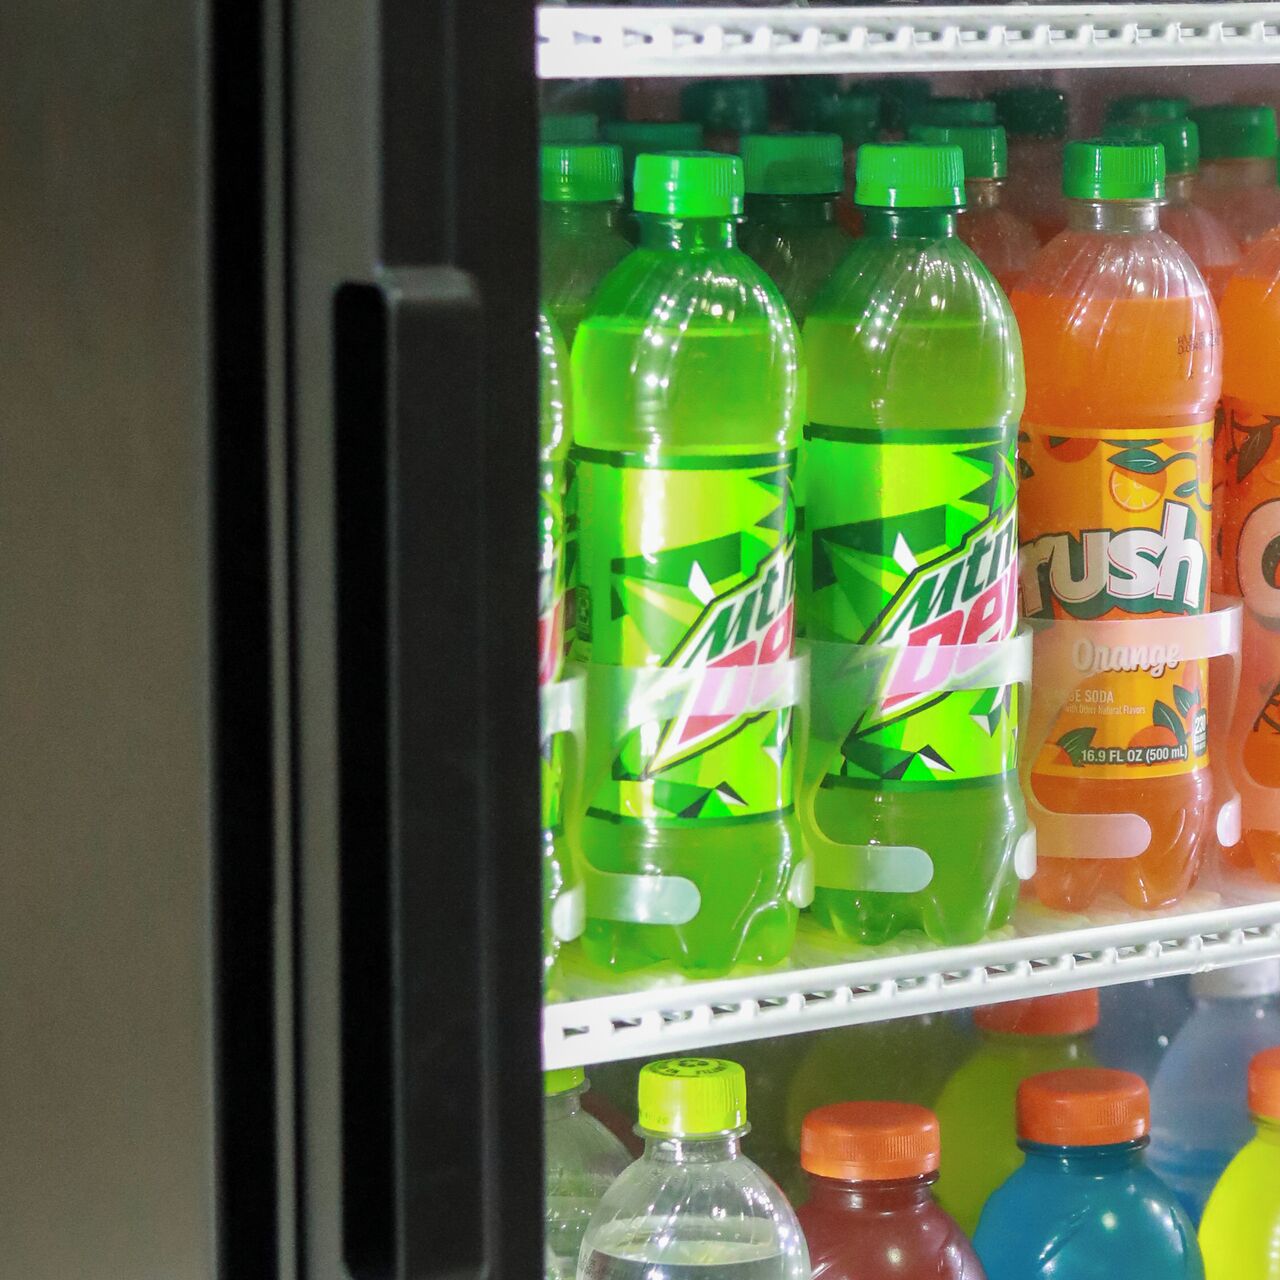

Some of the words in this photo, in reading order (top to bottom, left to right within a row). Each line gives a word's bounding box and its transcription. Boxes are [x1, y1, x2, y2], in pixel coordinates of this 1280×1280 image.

[1018, 502, 1205, 618] rush
[882, 560, 1018, 711] De
[1071, 638, 1181, 678] Orange
[1085, 689, 1114, 703] SODA
[1081, 749, 1106, 763] 16.9
[1109, 749, 1122, 762] FL
[1127, 749, 1142, 762] OZ
[1146, 747, 1169, 764] (500
[1171, 744, 1188, 762] mL)
